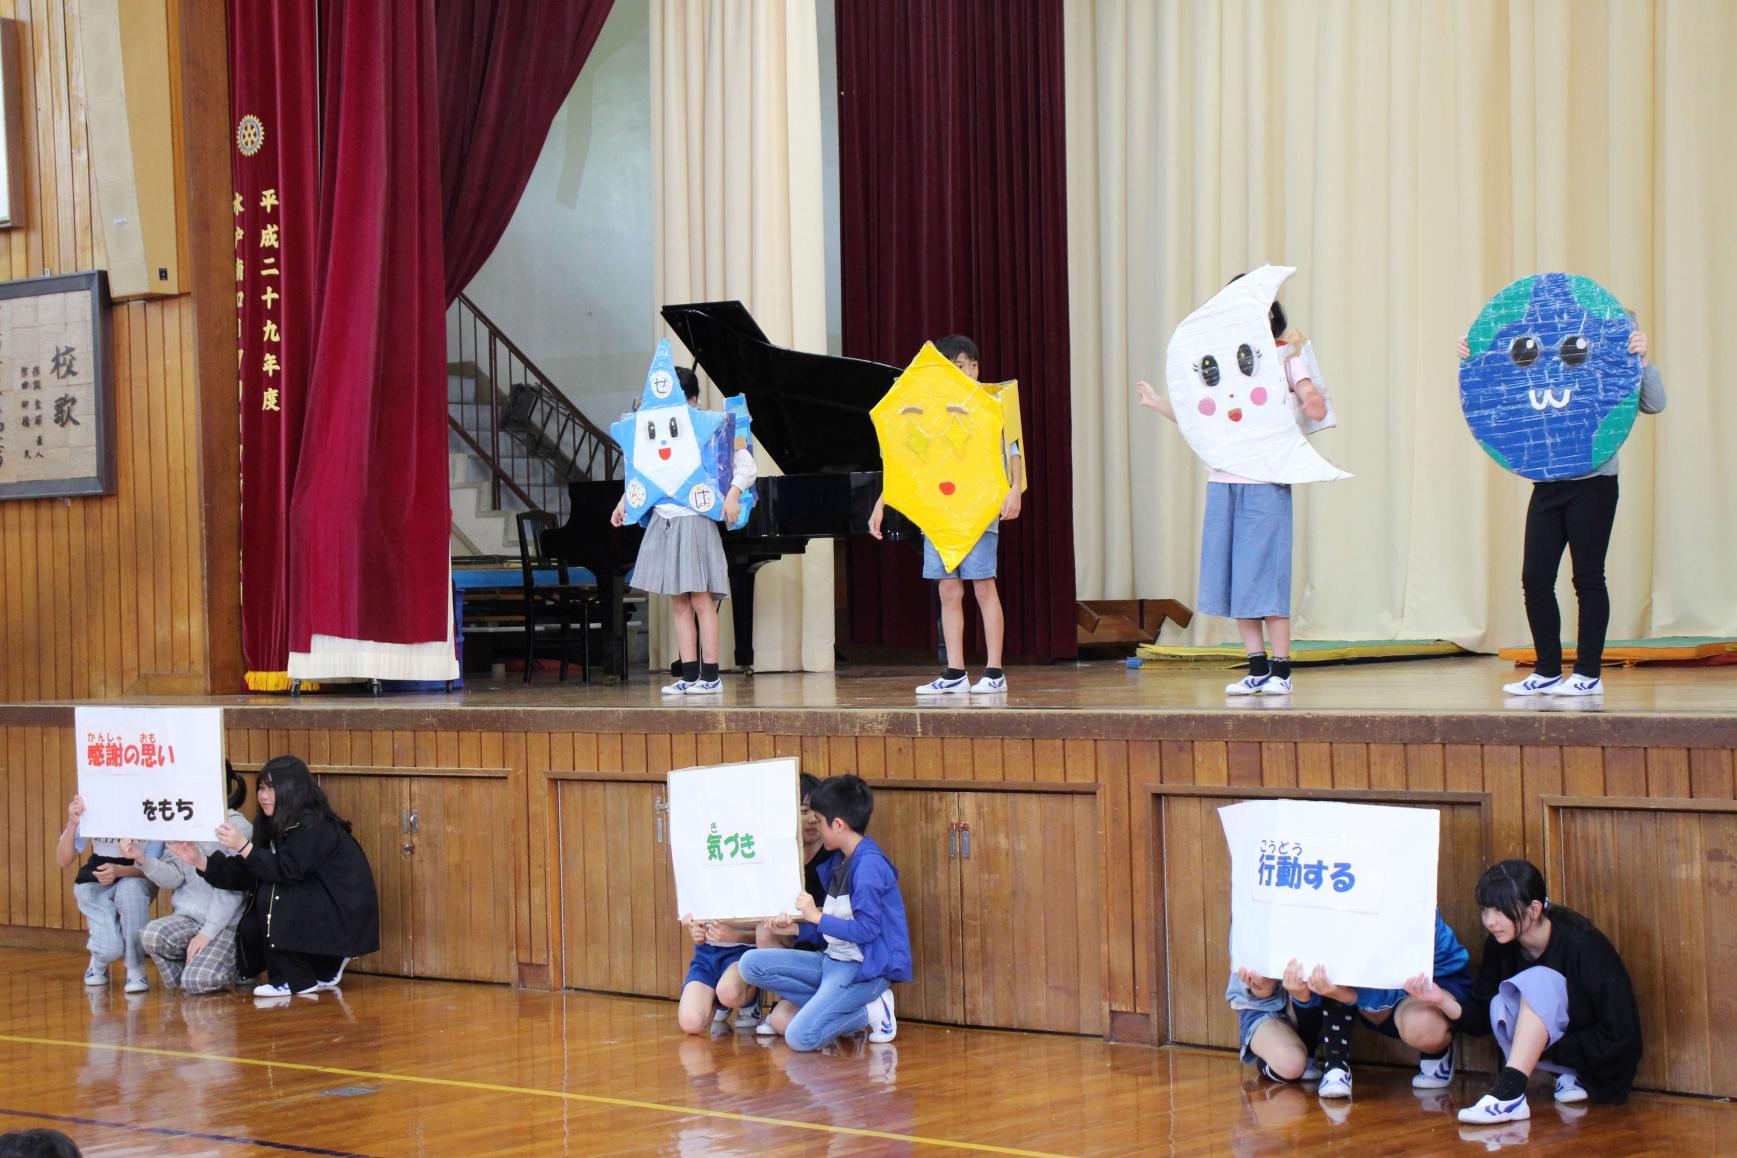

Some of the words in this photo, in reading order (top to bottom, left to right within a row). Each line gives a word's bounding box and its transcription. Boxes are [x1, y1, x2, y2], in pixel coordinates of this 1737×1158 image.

[260, 188, 281, 412] 平成二十九年度
[51, 345, 80, 428] 校歌
[87, 732, 122, 742] かんしゃ
[140, 732, 156, 743] おも
[87, 743, 175, 768] 感謝の思い
[142, 798, 194, 822] をもち
[710, 822, 718, 833] き
[706, 832, 756, 861] 気づき
[1258, 853, 1356, 893] 行動する
